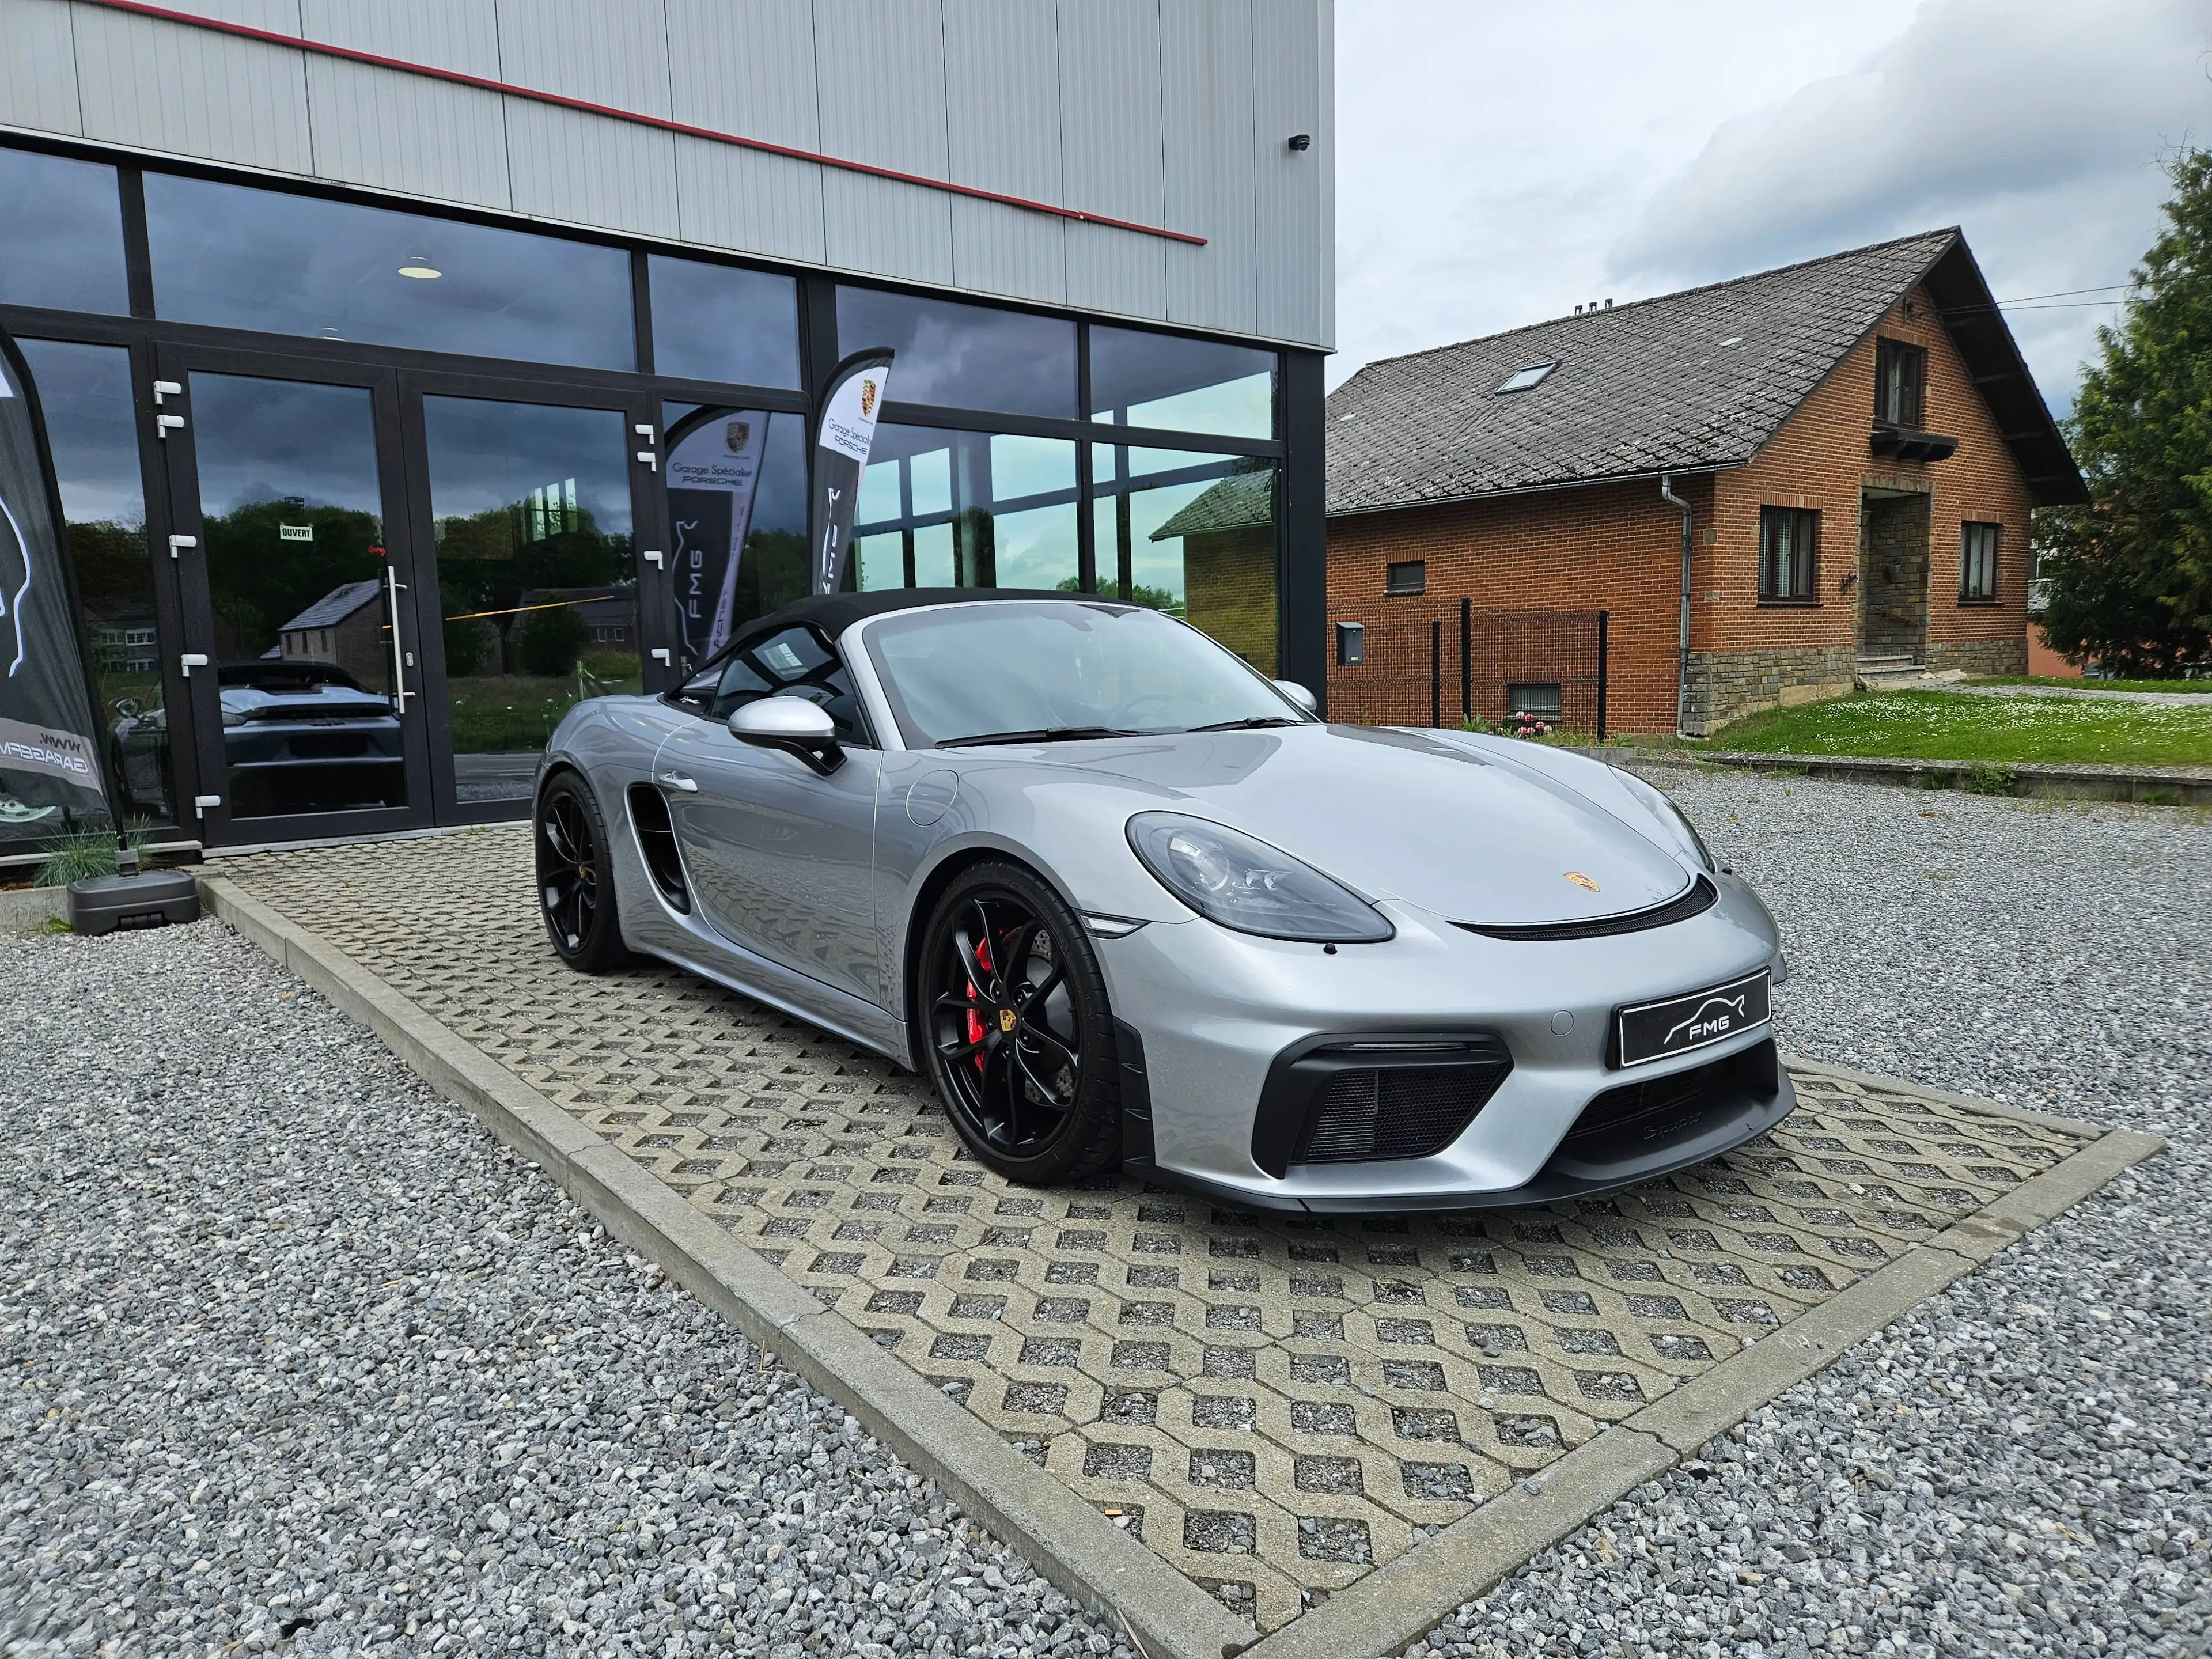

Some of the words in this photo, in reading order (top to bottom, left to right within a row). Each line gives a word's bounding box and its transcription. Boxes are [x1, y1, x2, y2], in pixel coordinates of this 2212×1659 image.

[828, 418, 850, 437] Garage
[835, 435, 868, 455] PORSCHE
[673, 462, 709, 475] Garage
[683, 476, 743, 486] PORSCHE
[282, 528, 310, 537] OUVERT
[689, 550, 703, 618] FMG
[1689, 1015, 1729, 1040] FMG
